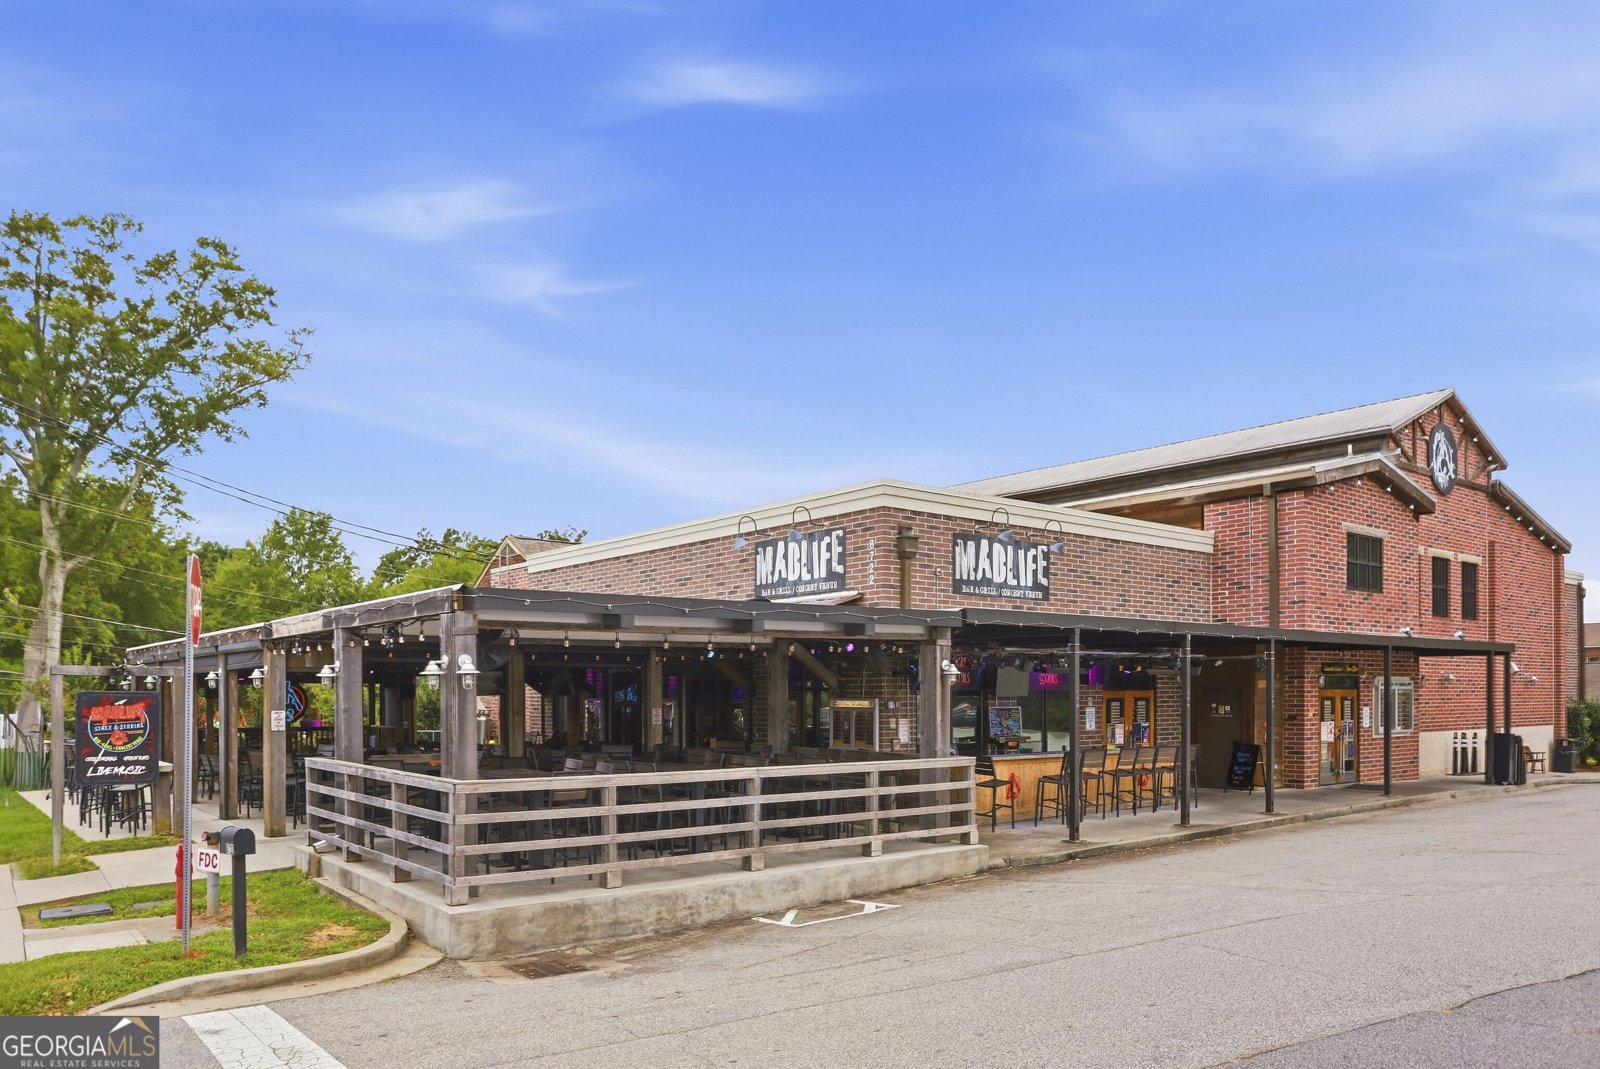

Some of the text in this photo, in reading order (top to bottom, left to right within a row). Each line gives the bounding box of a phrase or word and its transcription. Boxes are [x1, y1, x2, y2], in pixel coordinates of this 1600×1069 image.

[757, 530, 844, 585] MADLIFE
[955, 539, 1048, 587] MADLIFE
[761, 589, 771, 597] BAR
[776, 587, 792, 595] GRILL
[796, 583, 818, 593] CONCERT
[819, 581, 838, 590] VENUE
[962, 585, 974, 593] BAR
[980, 585, 997, 595] GRILL
[1001, 588, 1024, 598] CONCERT
[1026, 590, 1043, 599] VENUE
[199, 852, 218, 869] FDC
